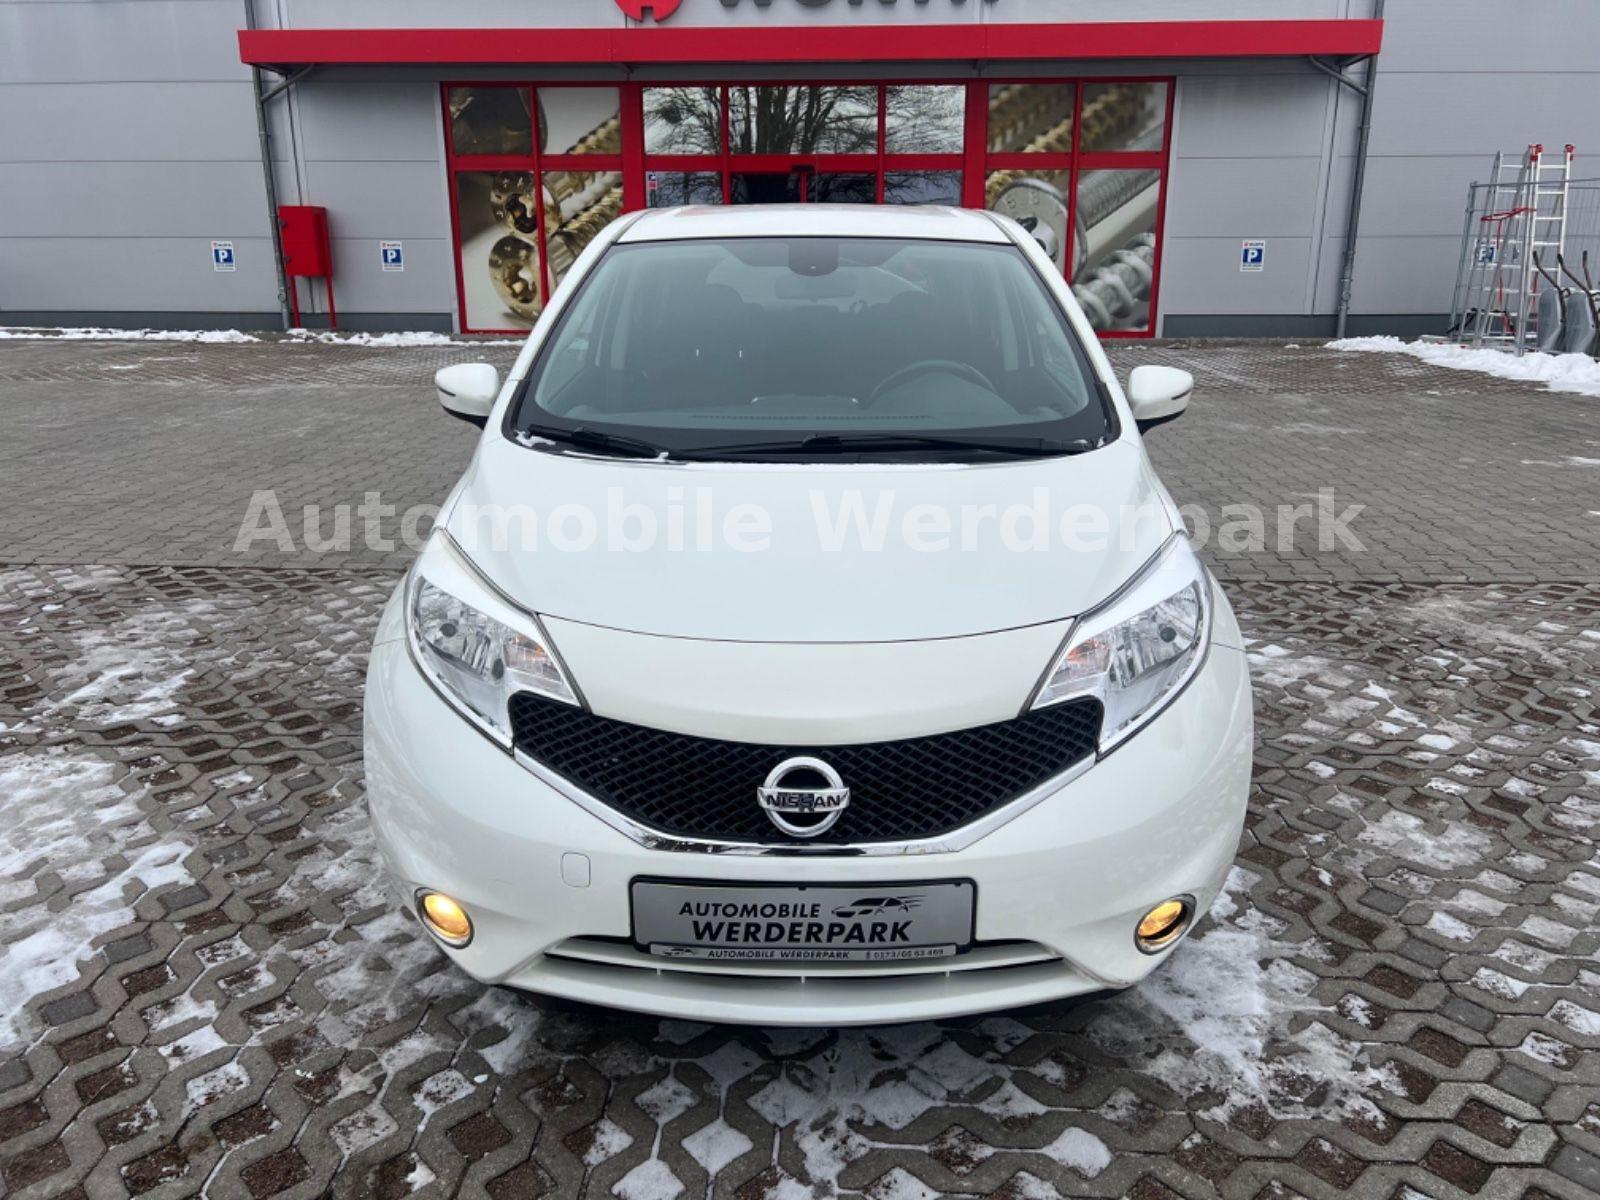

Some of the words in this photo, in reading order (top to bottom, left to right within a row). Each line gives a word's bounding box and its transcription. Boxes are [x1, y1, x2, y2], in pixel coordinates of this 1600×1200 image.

[218, 249, 228, 263] P
[386, 249, 397, 263] P
[1246, 250, 1258, 264] P
[766, 793, 841, 808] NISSAN
[679, 902, 821, 918] AUTOMOBILE
[692, 920, 912, 943] WERDERPARK
[708, 950, 774, 958] AUTOMOBILE
[780, 950, 850, 959] WERDERPARK
